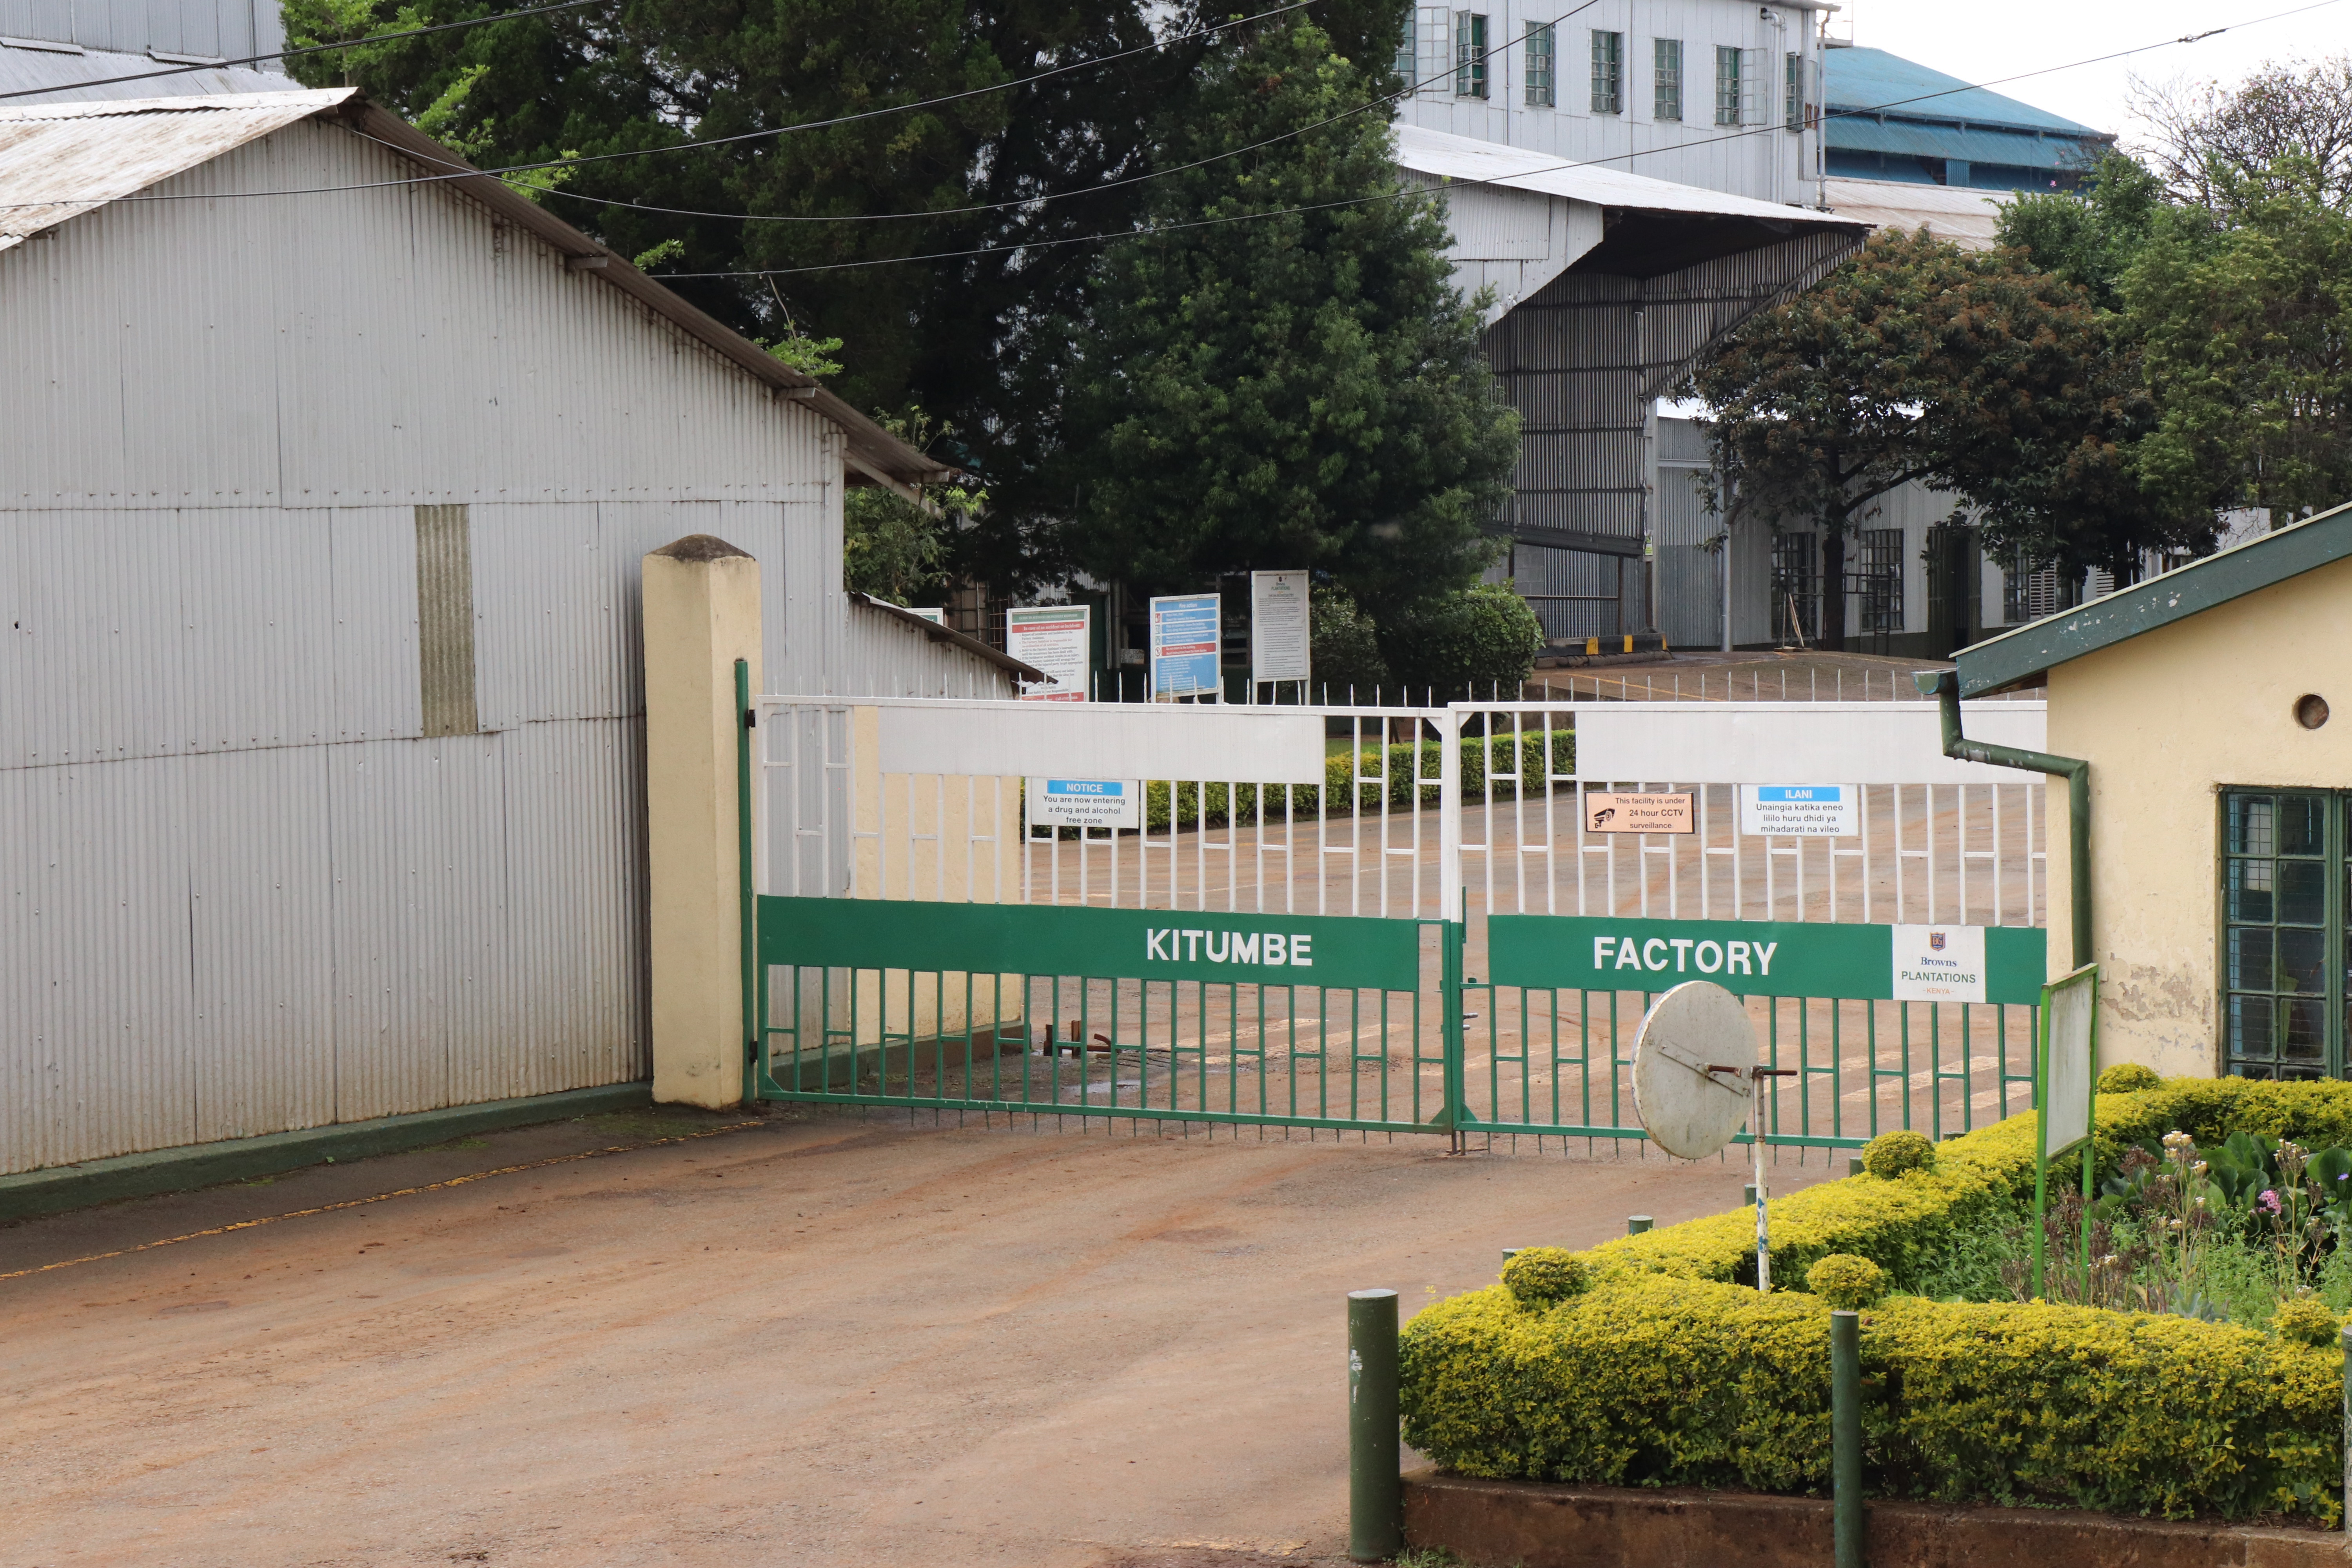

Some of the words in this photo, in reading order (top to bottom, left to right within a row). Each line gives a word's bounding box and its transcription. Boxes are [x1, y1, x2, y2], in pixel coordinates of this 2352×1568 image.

[1066, 783, 1103, 793] NOTICE
[1785, 789, 1812, 799] ILANI
[1093, 797, 1125, 806] entering
[1055, 806, 1073, 815] drug
[1756, 804, 1792, 812] Unaingia
[1147, 928, 1312, 966] KITUMBE
[1594, 936, 1778, 976] FACTORY
[1921, 957, 1957, 967] Browns
[1902, 971, 1976, 983] PLANTATIONS
